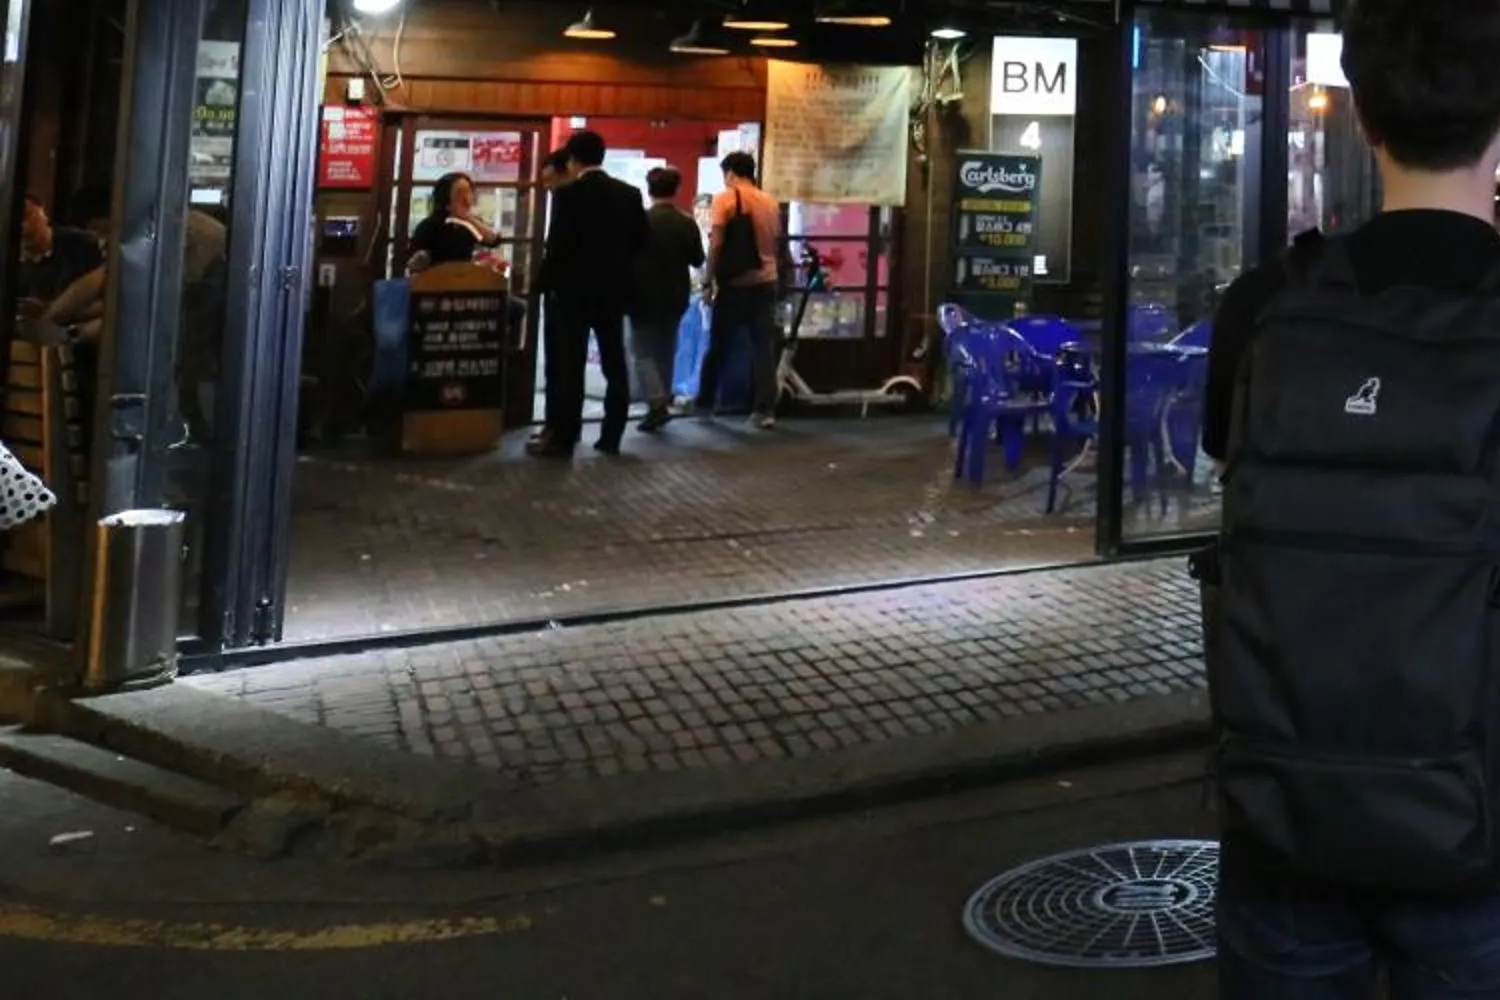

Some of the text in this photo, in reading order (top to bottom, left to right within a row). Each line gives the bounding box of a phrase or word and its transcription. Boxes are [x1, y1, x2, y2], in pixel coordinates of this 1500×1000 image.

[1002, 60, 1067, 96] BM
[1019, 121, 1041, 150] 4
[960, 160, 1036, 192] Carlsberg
